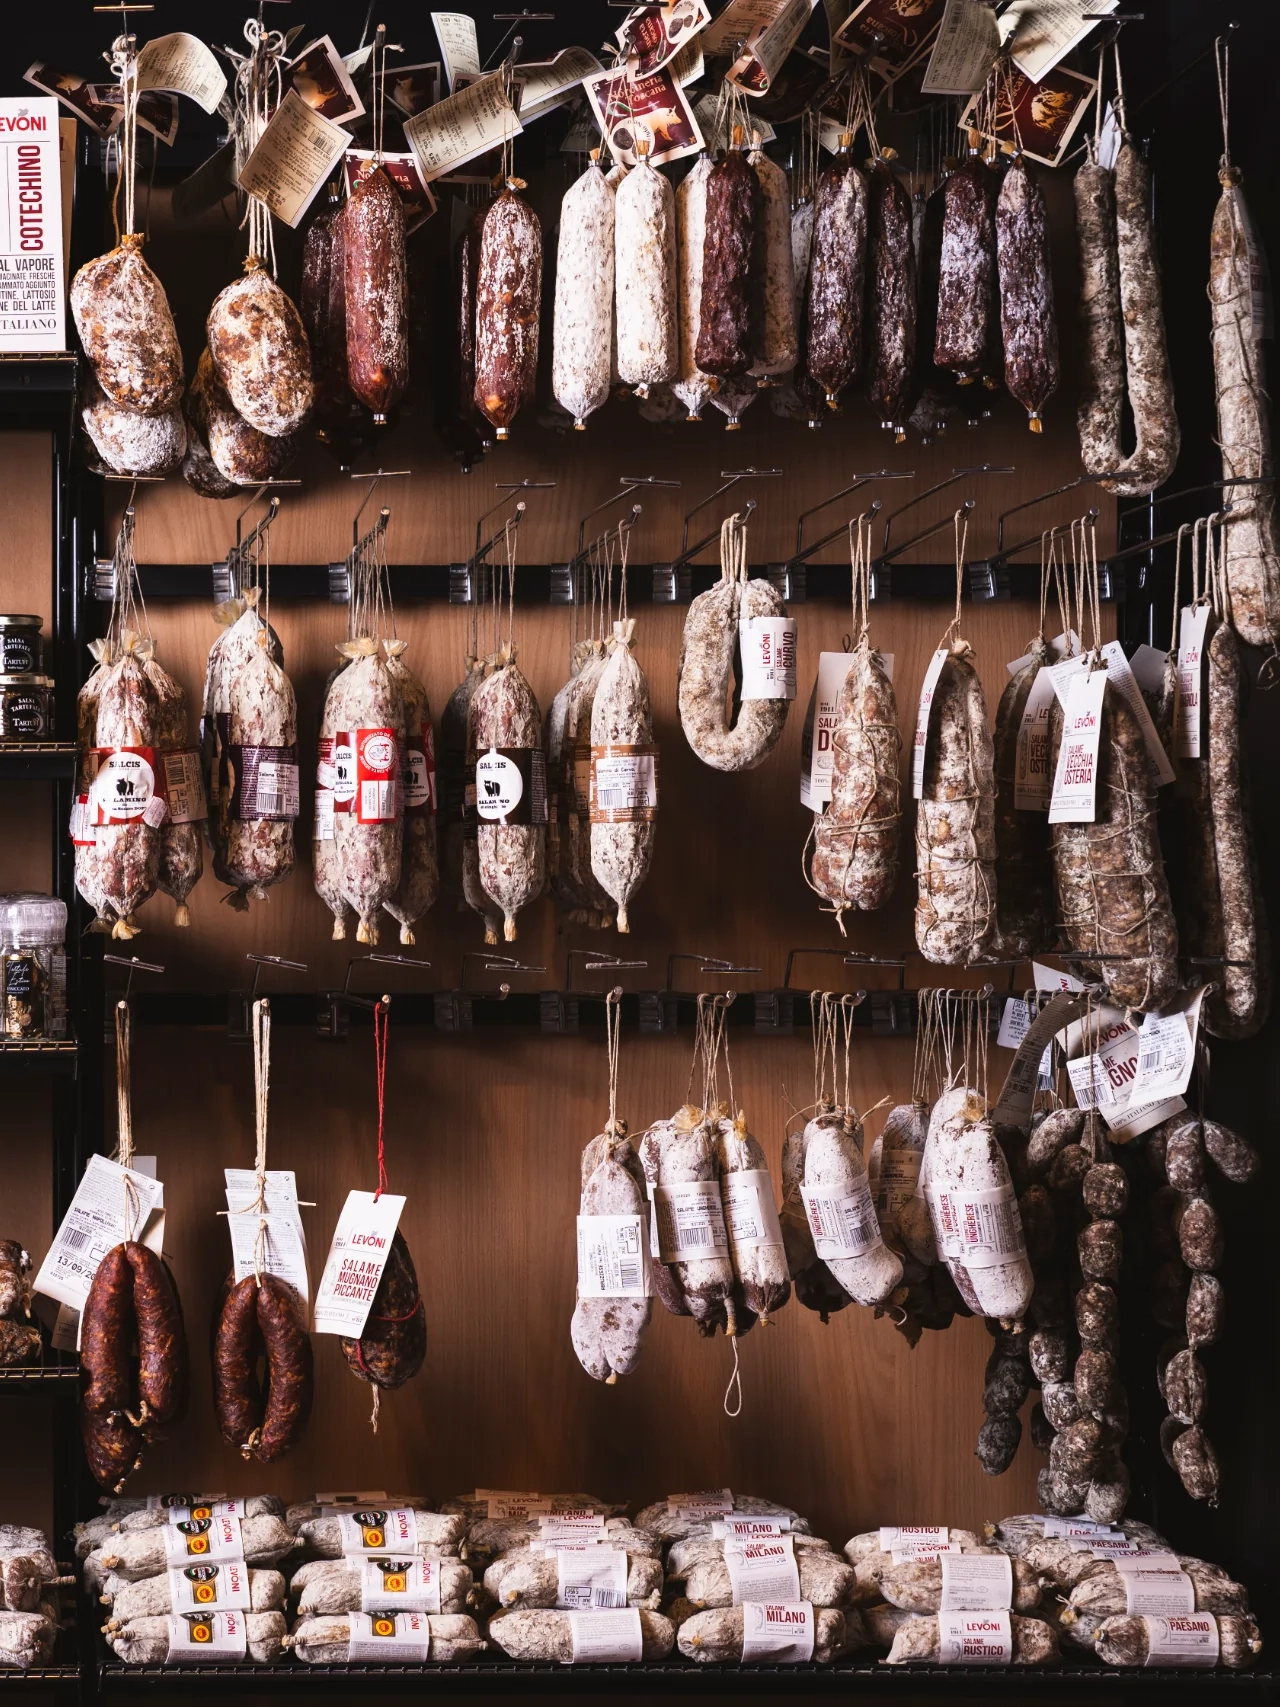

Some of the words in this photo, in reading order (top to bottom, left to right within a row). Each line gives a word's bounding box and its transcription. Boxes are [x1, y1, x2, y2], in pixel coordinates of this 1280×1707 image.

[18, 145, 43, 251] COTECHINO
[762, 633, 770, 664] LEVONI
[783, 631, 794, 669] CURVO
[818, 718, 838, 728] SALA
[1074, 716, 1096, 728] LEVONI
[1068, 744, 1084, 754] SALAME
[1066, 753, 1093, 768] VECCHIA
[1064, 769, 1092, 785] OSTERIA
[809, 1198, 823, 1236] UNGHERESE
[940, 1194, 954, 1233] UNGHERESE
[965, 1203, 979, 1243] UNGHERESE
[352, 1234, 386, 1248] LEVONI
[342, 1259, 382, 1276] SALAME
[338, 1272, 378, 1288] MUGNANO
[333, 1284, 374, 1301] PICCANTE
[221, 1517, 233, 1543] LEVONI
[397, 1511, 409, 1539] LEVONI
[734, 1524, 772, 1533] MILANO
[745, 1547, 784, 1559] MILANO
[229, 1565, 241, 1592] LEVONI
[766, 1611, 806, 1623] MILANO
[967, 1623, 1000, 1631] LEVONI
[1170, 1622, 1210, 1632] PAESANO
[964, 1646, 1003, 1655] RUSTICO
